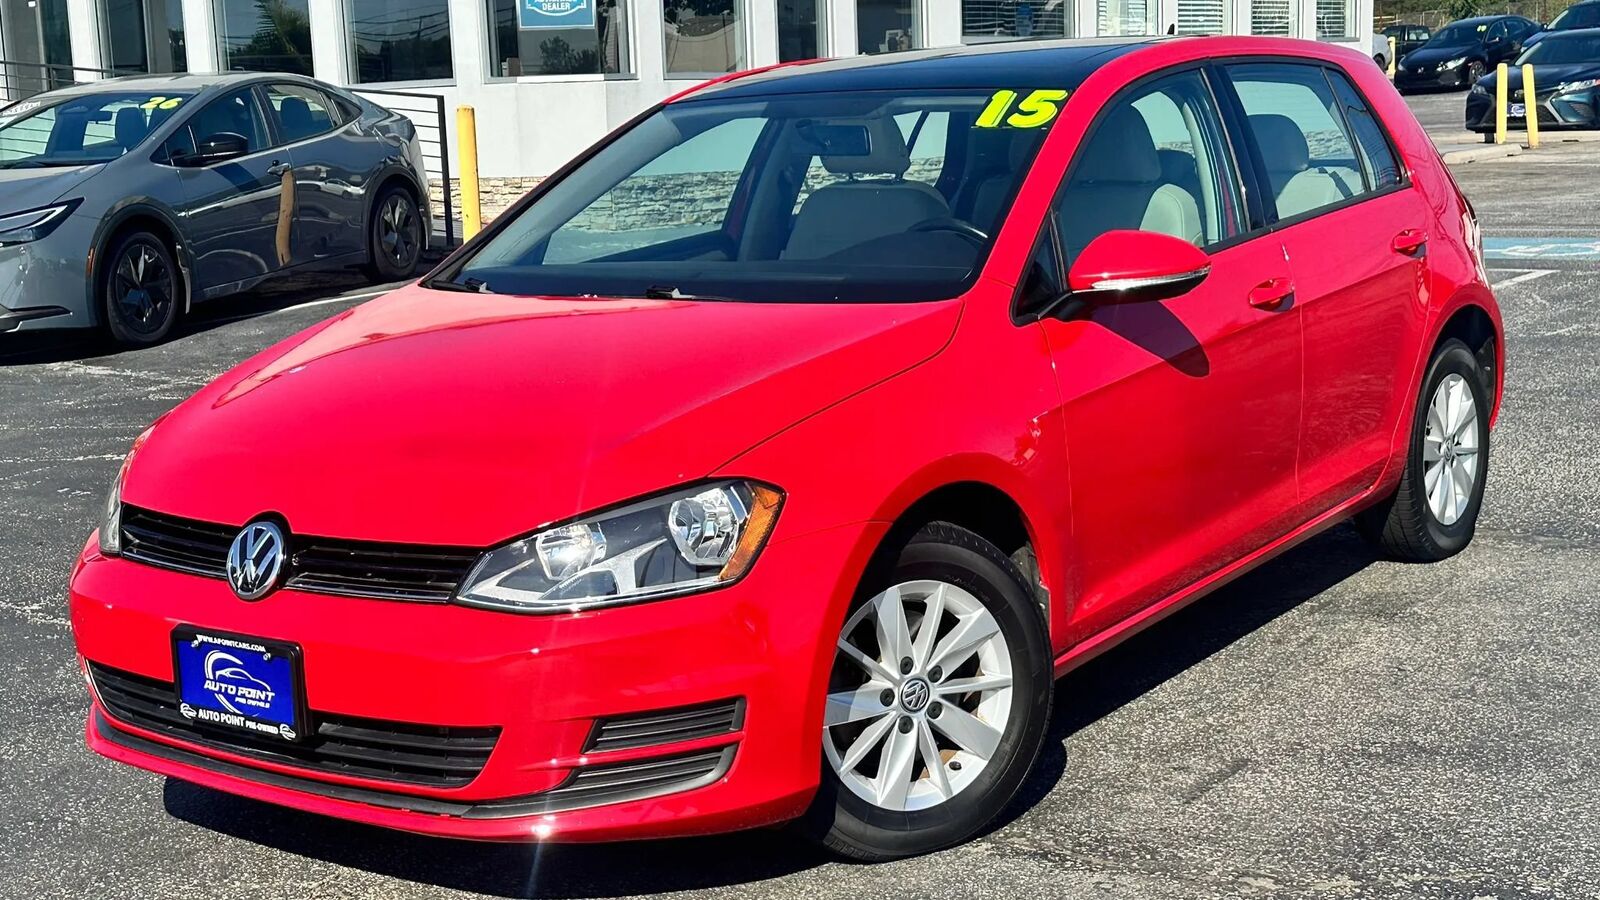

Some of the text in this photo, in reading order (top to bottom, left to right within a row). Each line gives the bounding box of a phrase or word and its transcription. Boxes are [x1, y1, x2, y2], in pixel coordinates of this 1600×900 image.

[140, 97, 182, 109] 26
[975, 90, 1068, 128] 15
[204, 680, 275, 702] AUTO POINT
[198, 709, 220, 722] AUTO
[220, 713, 245, 727] POINT
